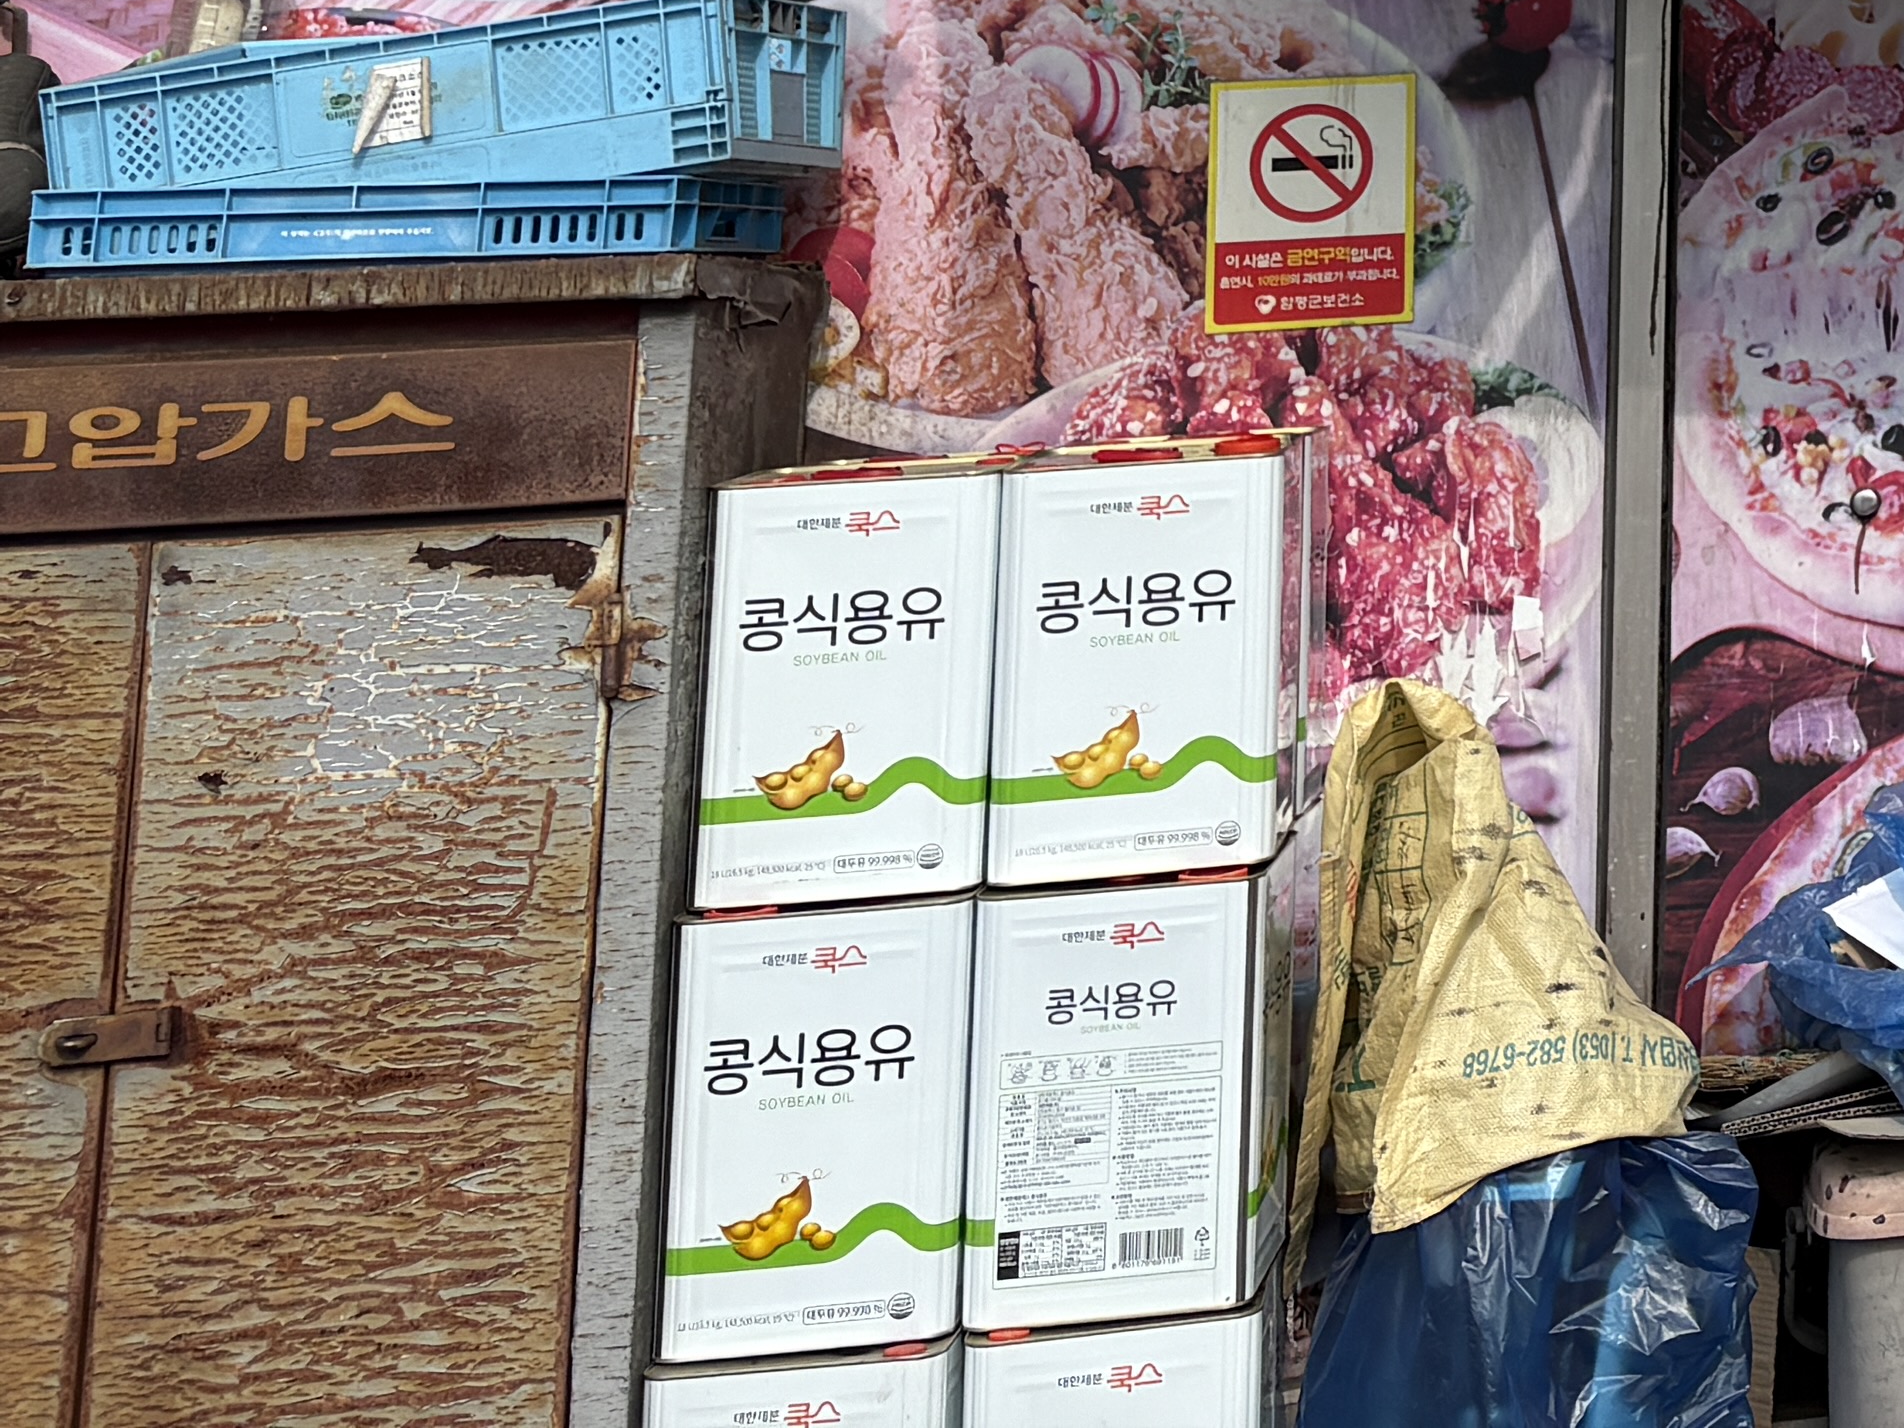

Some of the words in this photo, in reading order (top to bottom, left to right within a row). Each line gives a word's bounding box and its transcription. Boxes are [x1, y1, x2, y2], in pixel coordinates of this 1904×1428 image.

[1225, 254, 1239, 269] 이
[1036, 569, 1236, 634] 콩식용유
[739, 587, 945, 652] 콩식용유
[1089, 632, 1154, 648] SOYBEAN
[1158, 631, 1181, 643] OIL
[793, 651, 859, 667] SOYBEAN
[865, 650, 887, 662] OIL
[1045, 979, 1178, 1025] 콩식용유
[703, 1024, 915, 1096] 콩식용유
[758, 1094, 826, 1111] SOYBEAN
[832, 1092, 854, 1104] OIL
